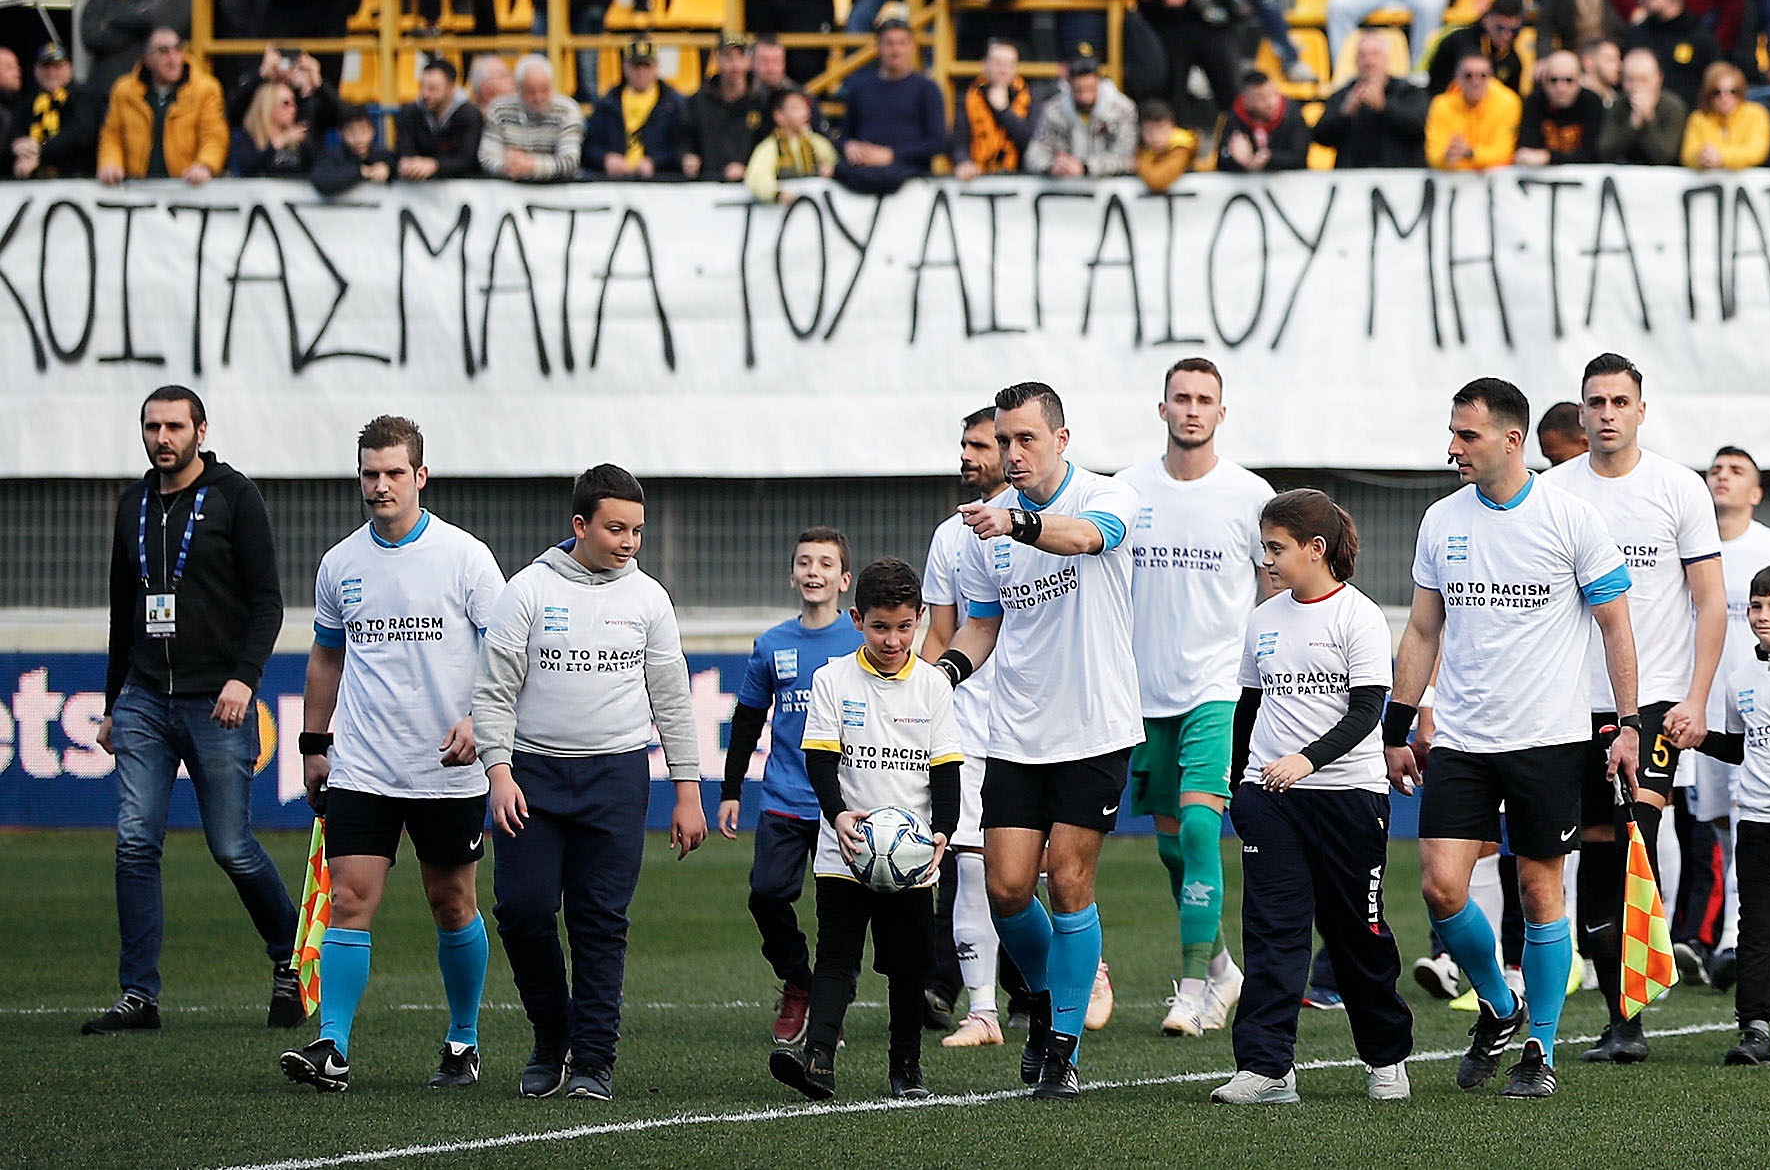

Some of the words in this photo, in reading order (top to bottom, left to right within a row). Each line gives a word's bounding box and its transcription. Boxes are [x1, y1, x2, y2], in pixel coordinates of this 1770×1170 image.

[714, 190, 886, 369] ΤΟΥ
[908, 184, 1337, 350] ΑΙΓΑΙΟΥ
[1366, 178, 1514, 349] ΜΗ
[1518, 176, 1654, 341] ΤΑ
[1151, 547, 1168, 557] TO
[1172, 547, 1223, 561] RACISM
[1013, 584, 1031, 597] TO
[1447, 582, 1463, 594] NO
[1468, 582, 1485, 594] TO
[1491, 583, 1550, 596] RACISM
[1449, 596, 1463, 606] ΟΧΙ
[1465, 597, 1485, 606] ΣΤΟ
[367, 619, 384, 631] TO
[388, 617, 443, 629] RACISM
[367, 632, 384, 642] ΣΤΟ
[388, 631, 442, 641] ΡΑΤΣΙΣΜΟ
[539, 648, 561, 660] NO
[569, 649, 590, 661] TO
[540, 660, 560, 671] ΟΧΙ
[566, 663, 591, 672] ΣΤΟ
[1275, 673, 1292, 684] TO
[1297, 672, 1349, 684] RACISM
[1298, 684, 1350, 695] ΡΑΤΣΙΣΜΟ
[795, 690, 811, 702] TO
[859, 746, 876, 758] TO
[1652, 734, 1672, 767] 5
[856, 759, 876, 769] ΣΤΟ
